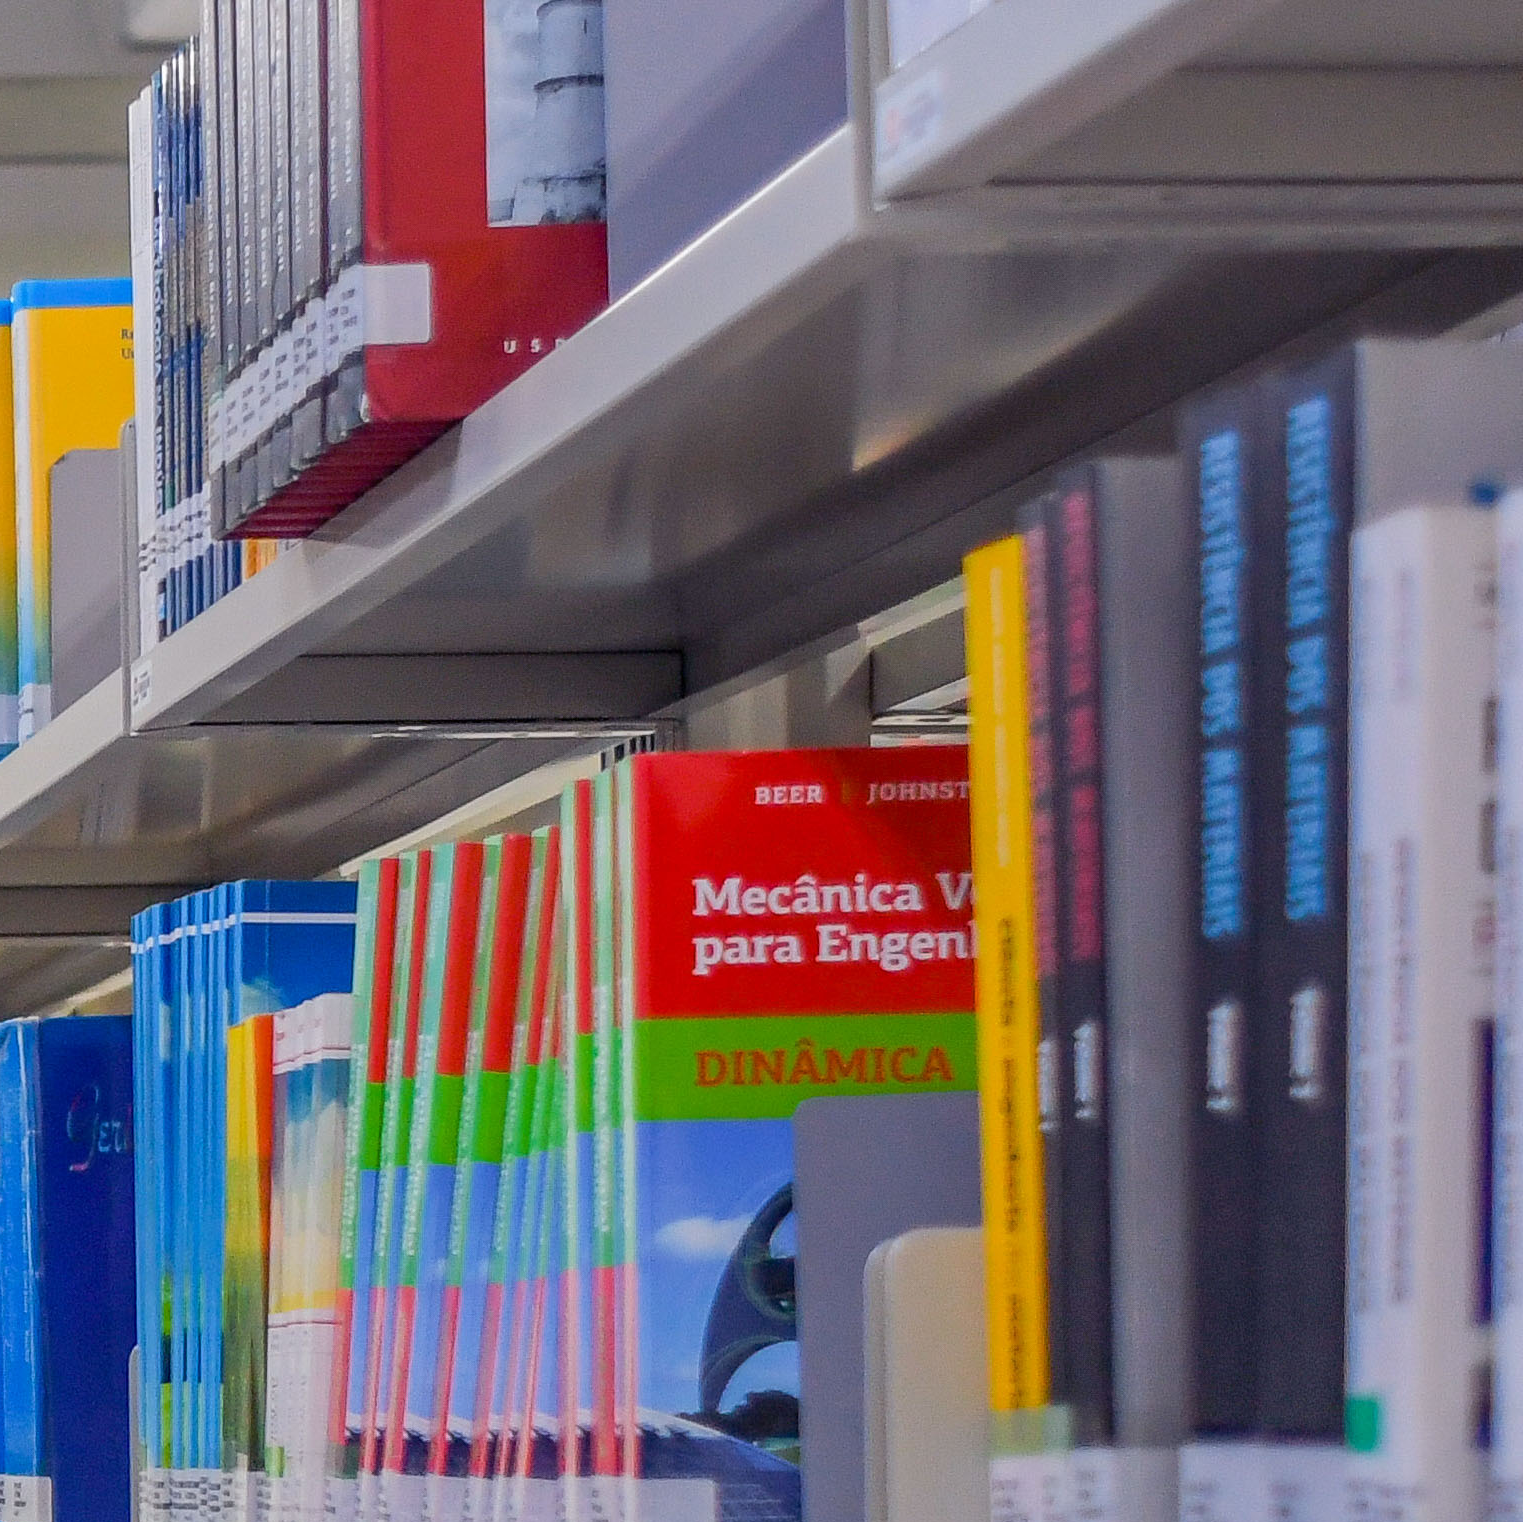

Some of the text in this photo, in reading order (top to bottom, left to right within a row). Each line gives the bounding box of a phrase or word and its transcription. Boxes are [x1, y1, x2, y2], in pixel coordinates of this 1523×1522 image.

[754, 784, 824, 806] BEER
[691, 871, 975, 917] Mecânica V
[691, 935, 803, 977] para
[694, 1036, 954, 1089] DINÂMICA
